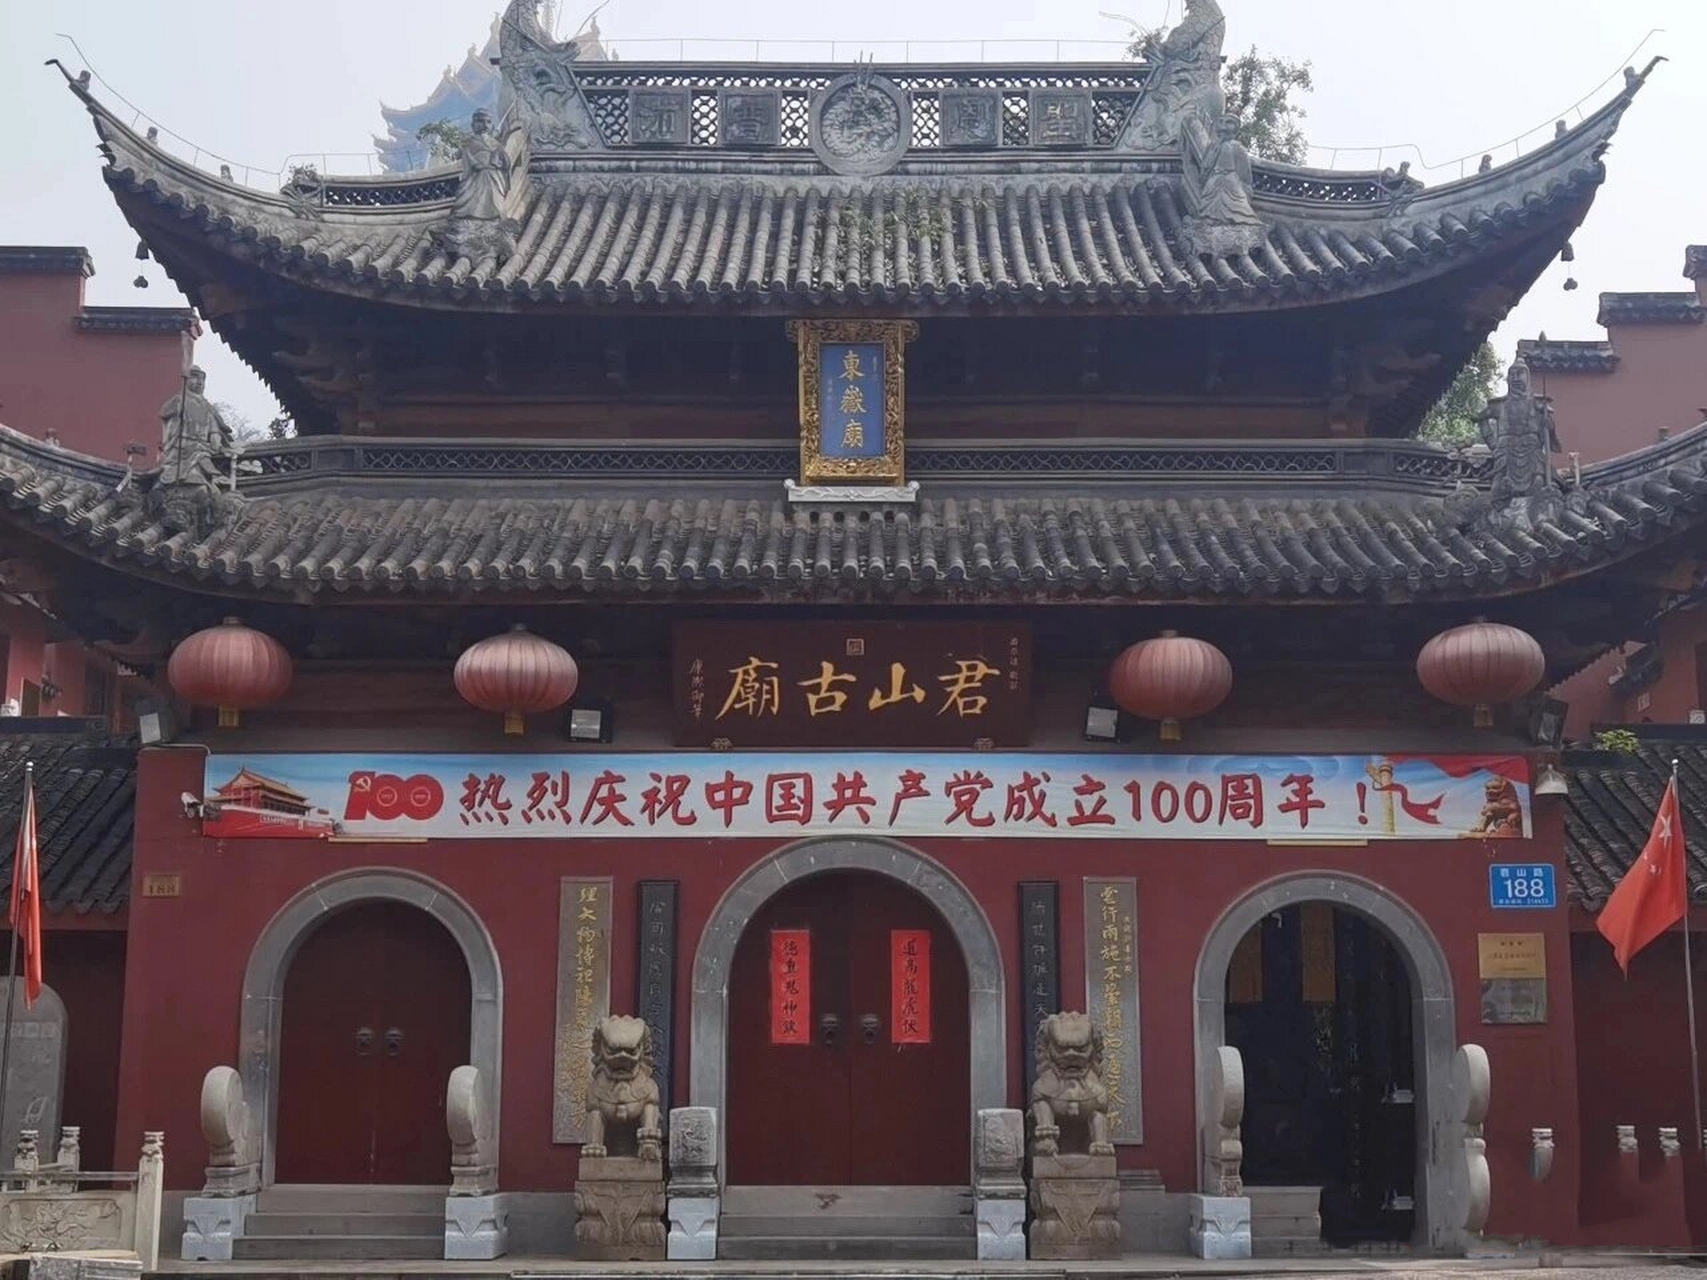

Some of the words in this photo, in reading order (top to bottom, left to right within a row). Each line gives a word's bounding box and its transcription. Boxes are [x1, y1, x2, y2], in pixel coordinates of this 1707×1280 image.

[715, 656, 1001, 720] 君山古廟
[1503, 878, 1544, 898] 188
